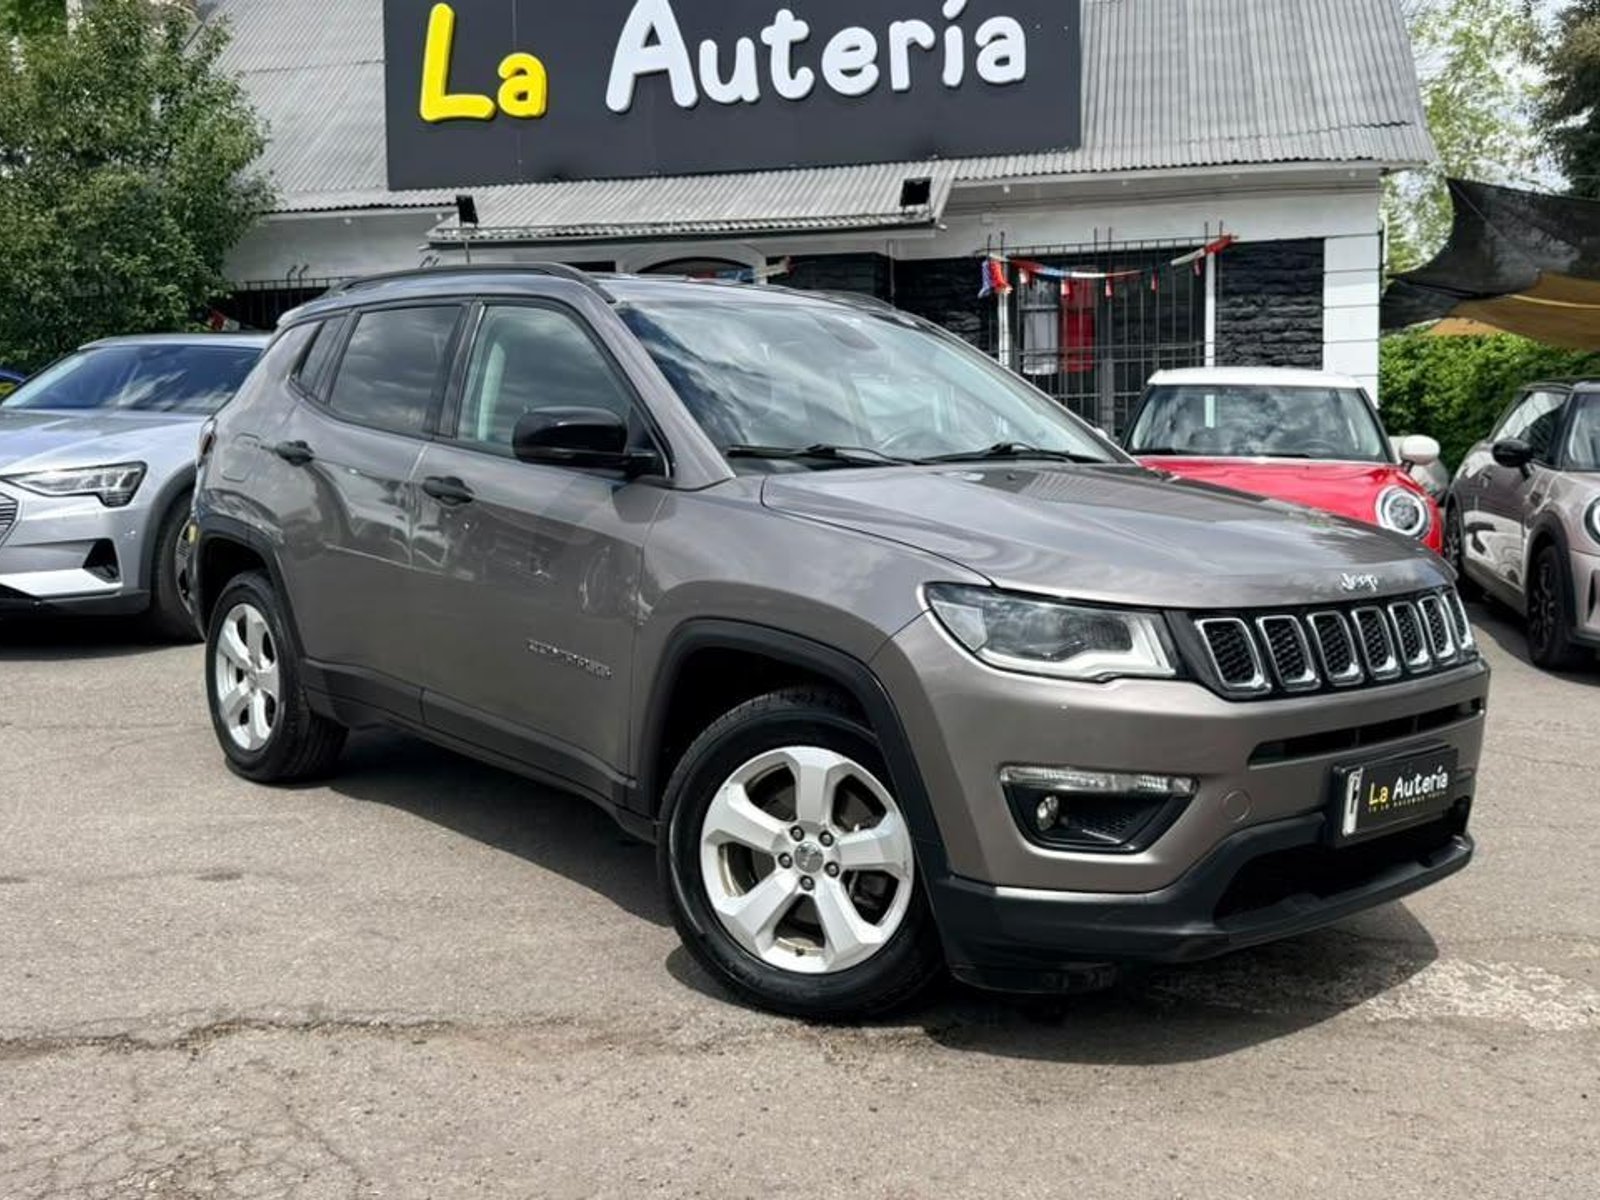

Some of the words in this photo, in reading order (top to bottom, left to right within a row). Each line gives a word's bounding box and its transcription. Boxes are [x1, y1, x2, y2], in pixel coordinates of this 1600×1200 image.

[419, 3, 548, 122] La
[605, 0, 1026, 112] Autería
[1369, 782, 1389, 805] La
[1392, 765, 1448, 800] Autería
